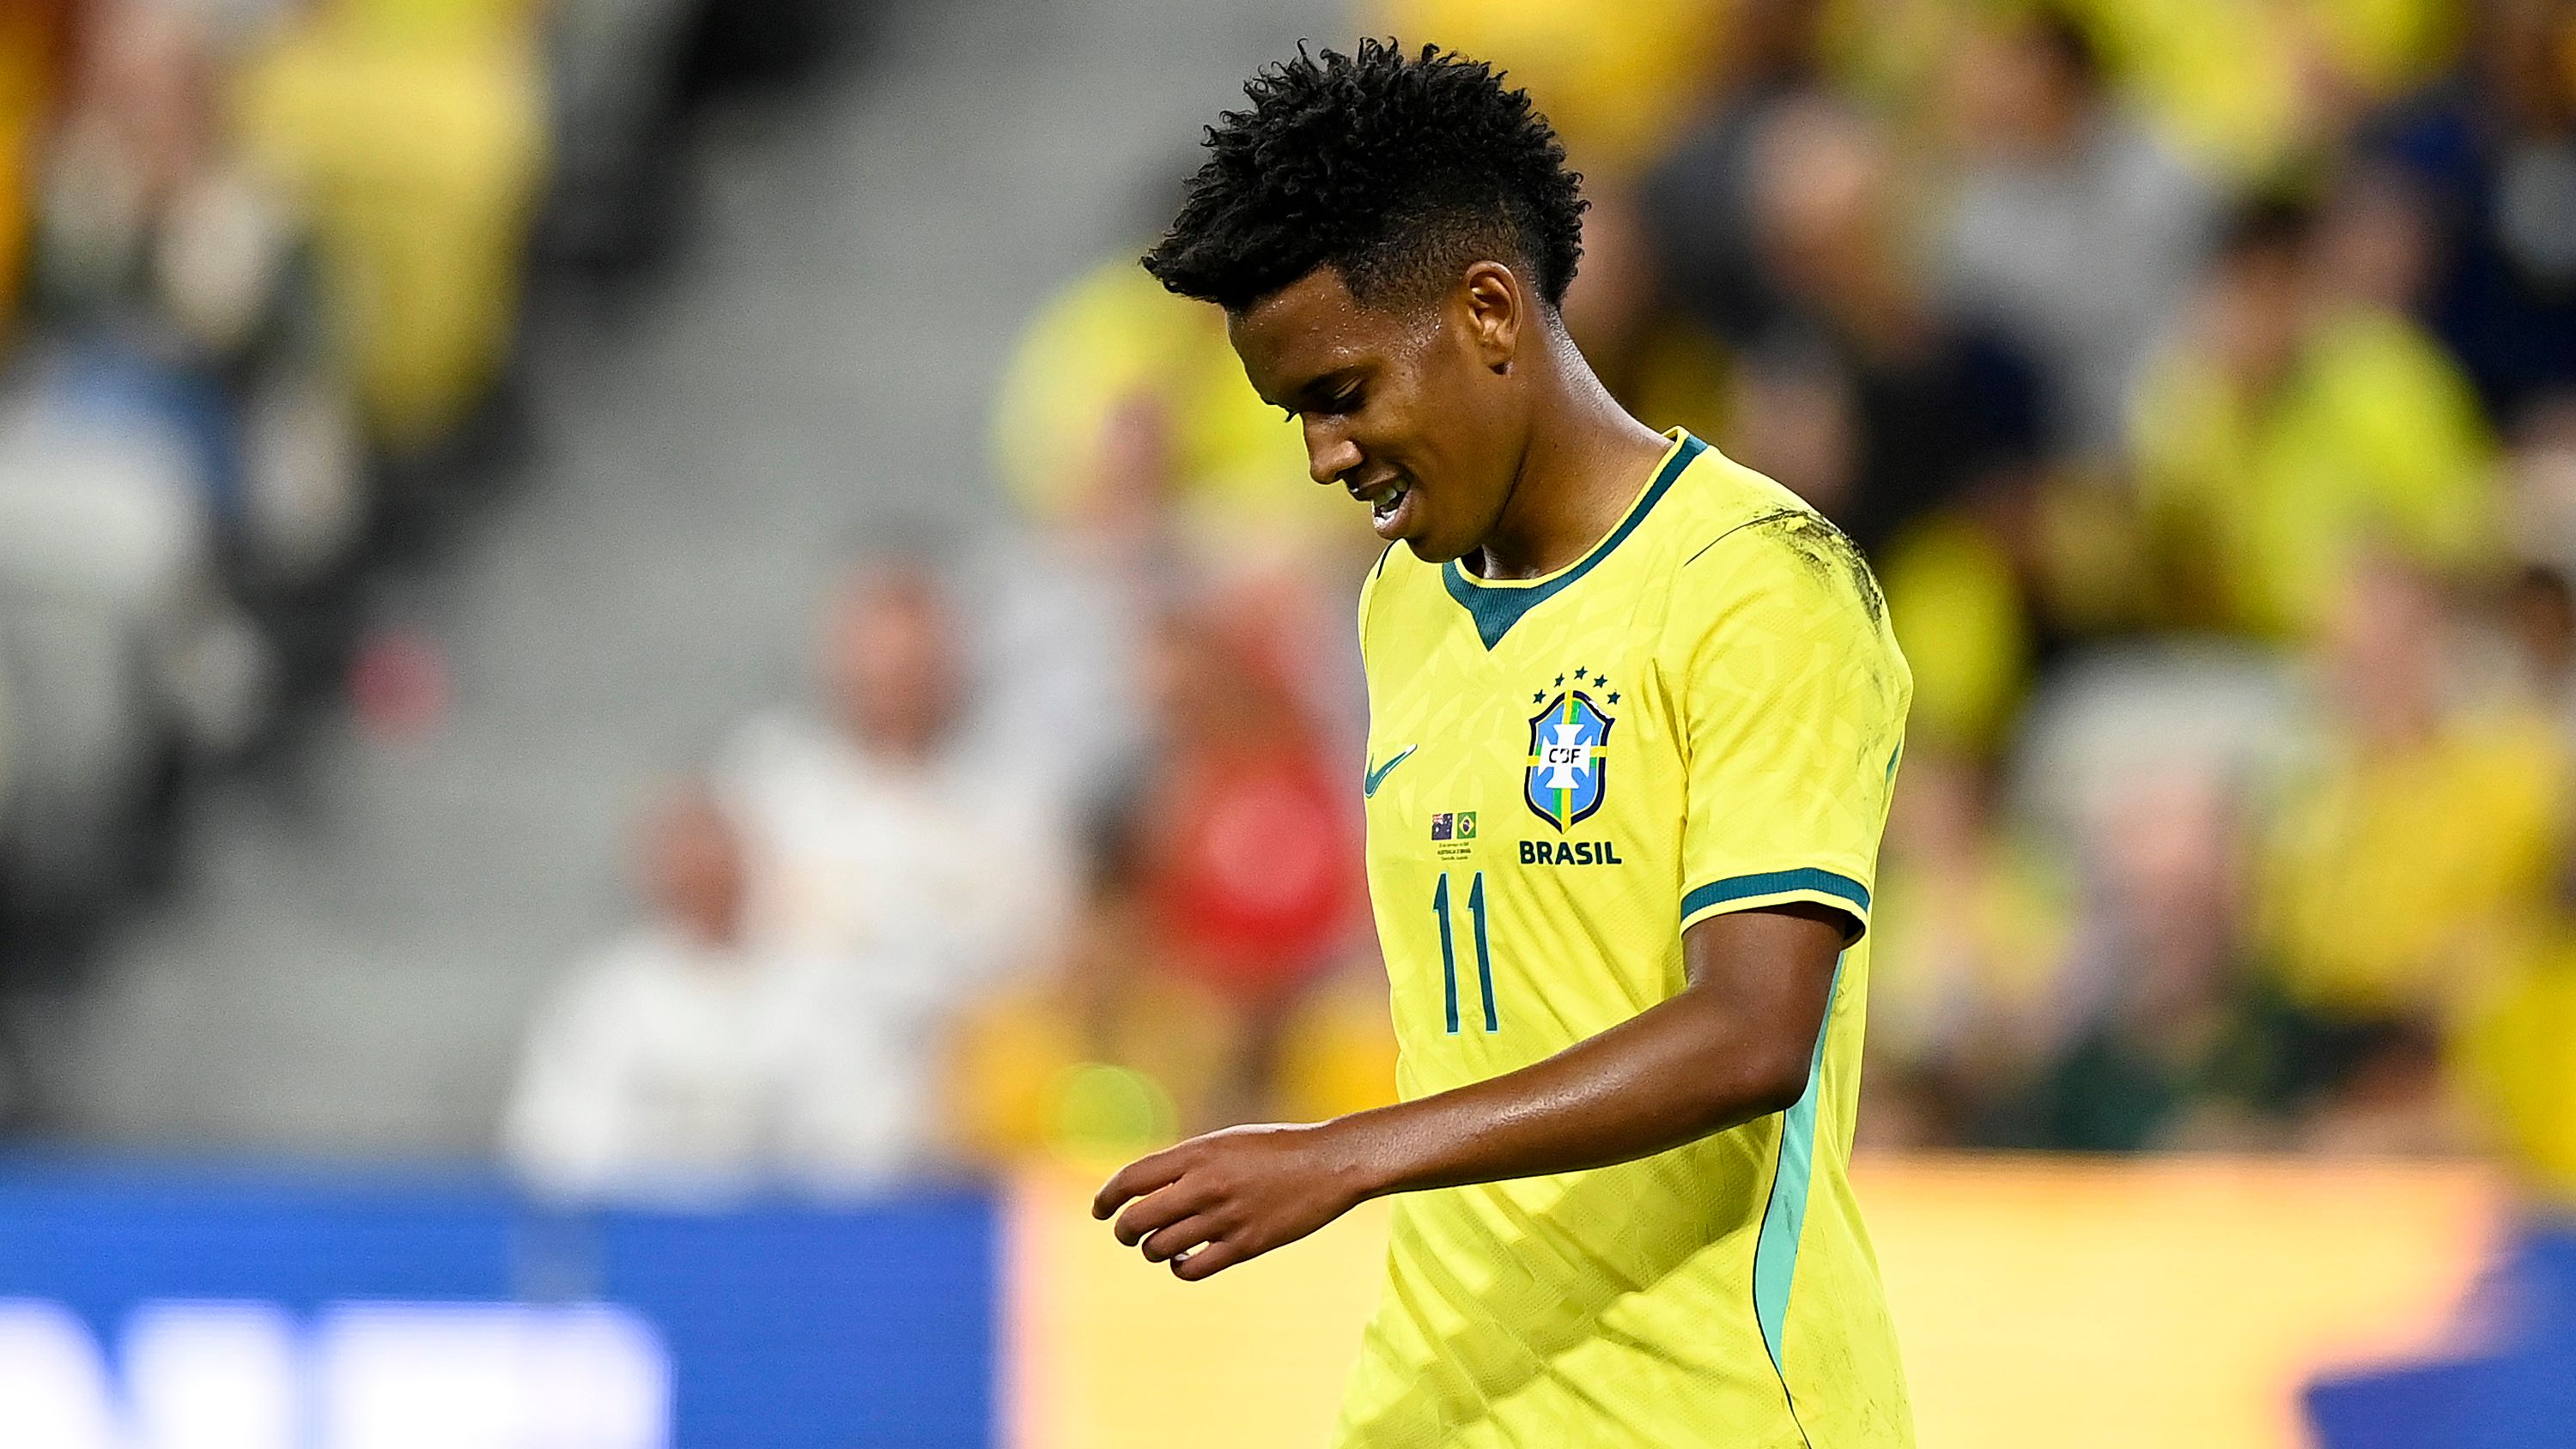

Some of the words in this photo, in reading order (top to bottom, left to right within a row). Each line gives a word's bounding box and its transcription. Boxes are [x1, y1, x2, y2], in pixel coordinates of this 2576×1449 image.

[1548, 748, 1581, 764] CBF
[1519, 840, 1622, 865] BRASIL
[1432, 871, 1498, 1034] 11
